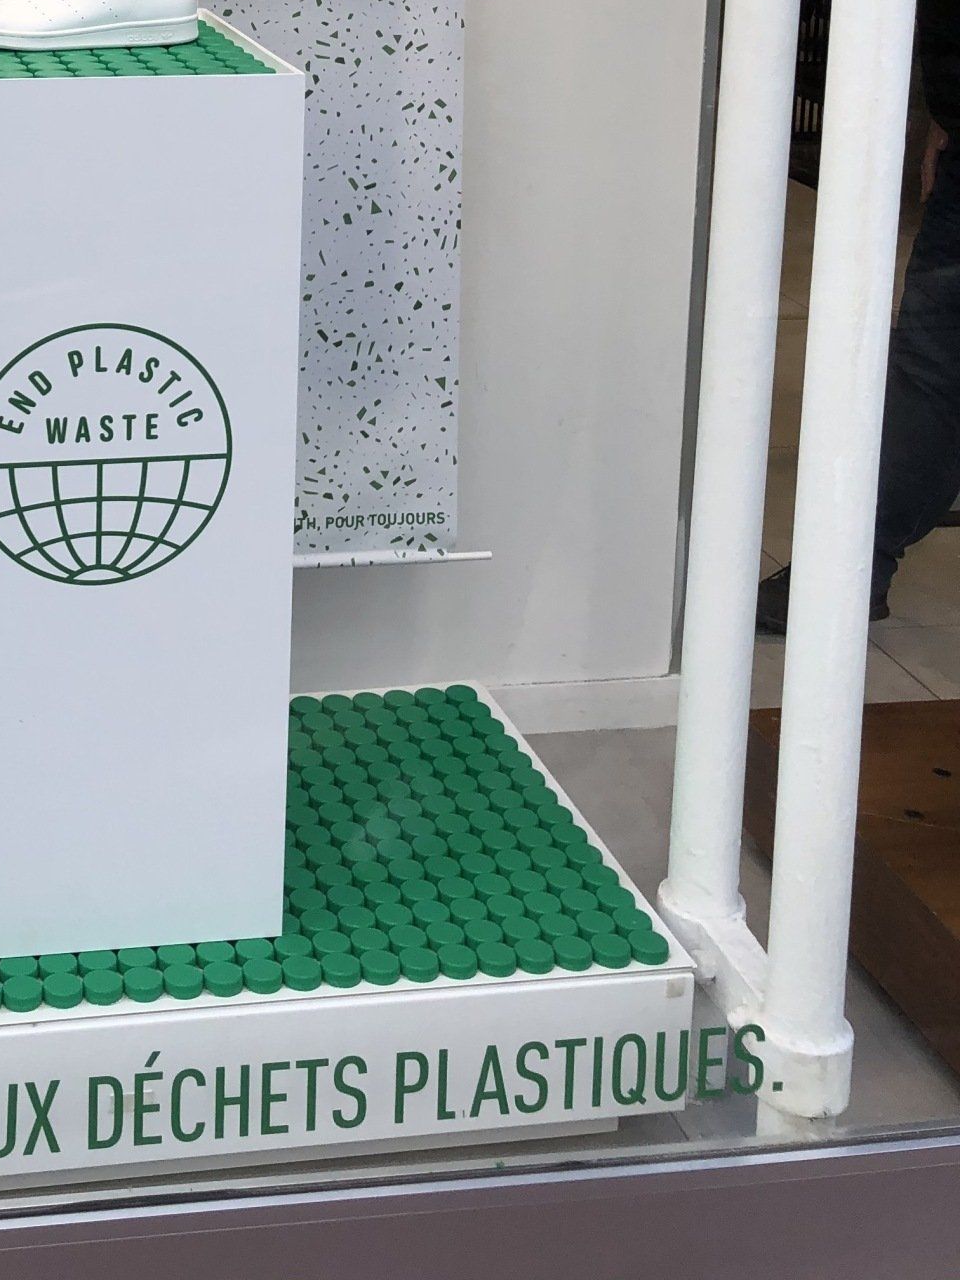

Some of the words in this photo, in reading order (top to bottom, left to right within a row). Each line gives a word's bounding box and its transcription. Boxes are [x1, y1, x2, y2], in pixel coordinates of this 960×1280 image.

[67, 346, 203, 427] PLASTIC
[46, 414, 158, 444] WASTE
[325, 514, 365, 529] POUR
[369, 512, 446, 527] TOUJOURS
[87, 1050, 367, 1151] DÉCHETS
[395, 1023, 784, 1124] PLASTIQUES.
